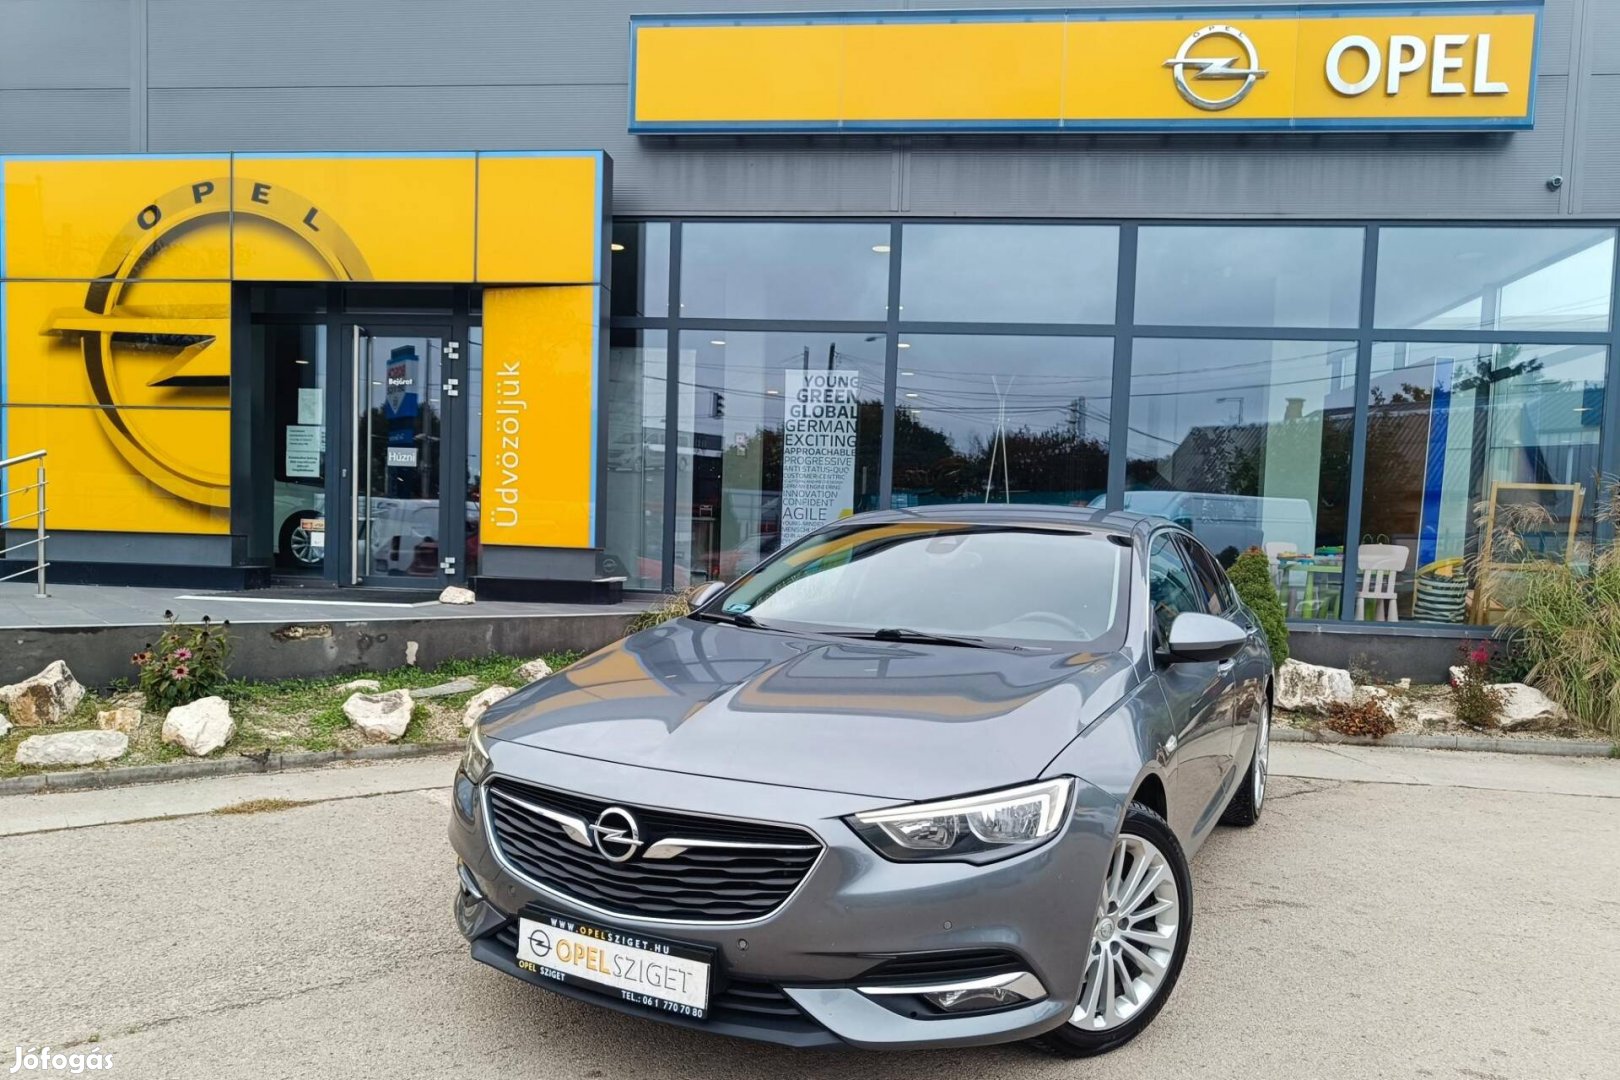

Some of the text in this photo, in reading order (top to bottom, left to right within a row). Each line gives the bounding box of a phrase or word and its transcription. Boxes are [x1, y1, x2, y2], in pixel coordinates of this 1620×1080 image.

[1193, 25, 1245, 39] OPEL
[1325, 33, 1510, 96] OPEL
[136, 181, 320, 232] OPEL
[804, 376, 859, 388] YOUNG
[797, 389, 859, 404] GREEN
[790, 404, 858, 419] GLOBAL
[785, 419, 857, 433] GERMAN
[491, 361, 527, 527] Üdvözöljük
[785, 434, 857, 447] EXCITING
[388, 452, 416, 462] Húzni
[784, 447, 856, 457] APPROACHABLE
[784, 456, 852, 466] PROGRESSIVE
[783, 490, 838, 499] INNOVATION
[783, 498, 834, 507] CONFIDENT
[782, 506, 828, 521] AGILE
[550, 917, 670, 955] WWW.OPELSZIGET.HU
[518, 959, 565, 981] OPEL SZIGET
[621, 990, 641, 1003] TEL.:
[642, 995, 653, 1006] 06
[663, 1000, 678, 1012] 770
[680, 1004, 690, 1015] 70
[692, 1007, 703, 1018] 80
